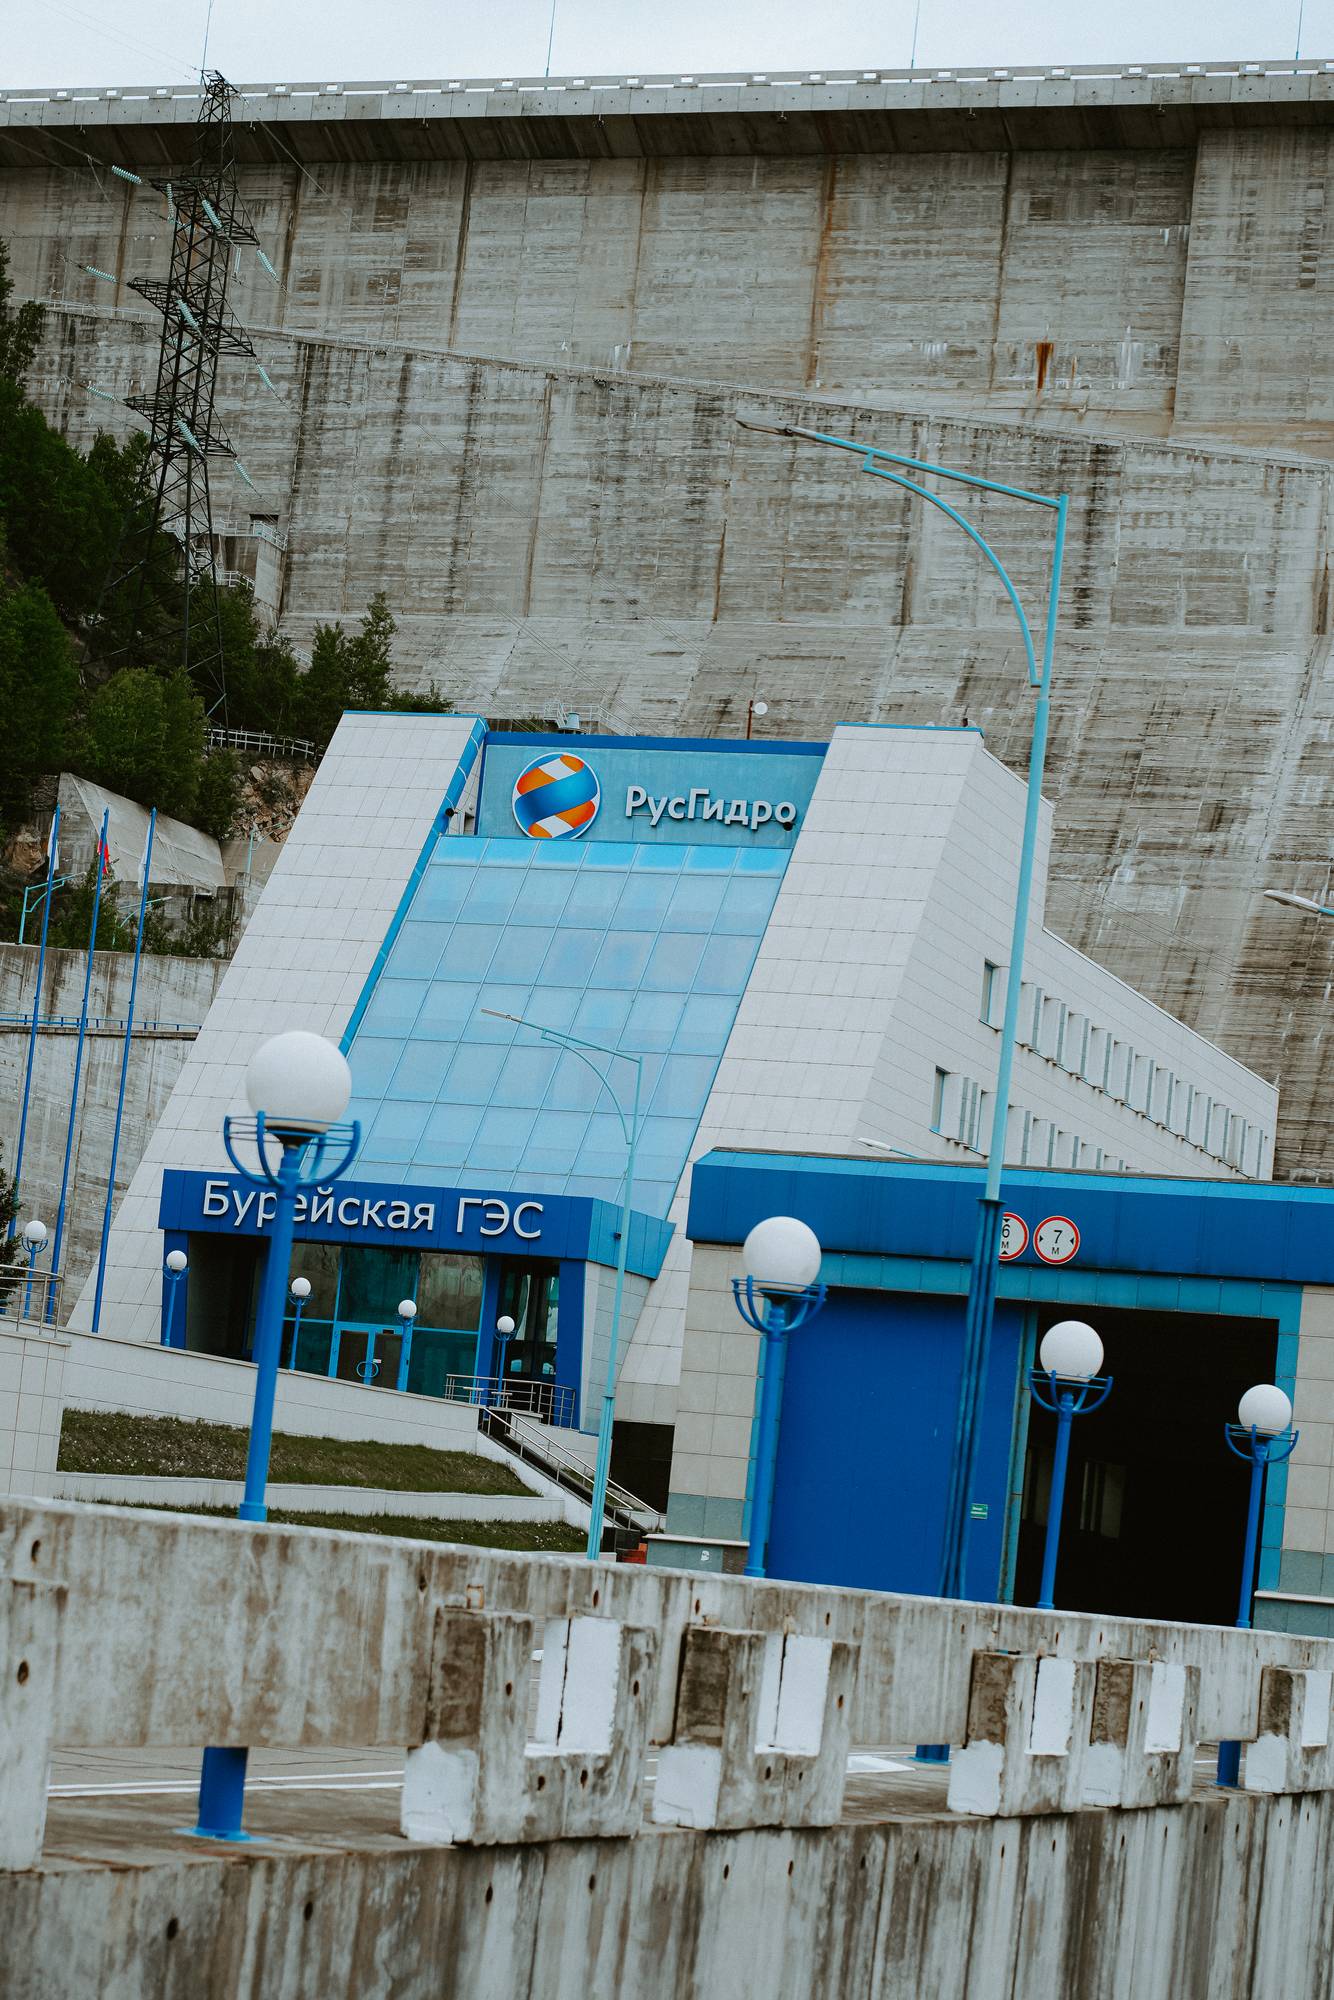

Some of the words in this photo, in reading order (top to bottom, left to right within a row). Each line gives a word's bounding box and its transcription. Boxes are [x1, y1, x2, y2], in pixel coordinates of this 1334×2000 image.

[625, 785, 797, 830] РусГидро
[203, 1180, 435, 1231] Бурейская
[456, 1197, 544, 1239] ГЭС
[1002, 1224, 1011, 1238] 6
[1053, 1229, 1063, 1244] 7
